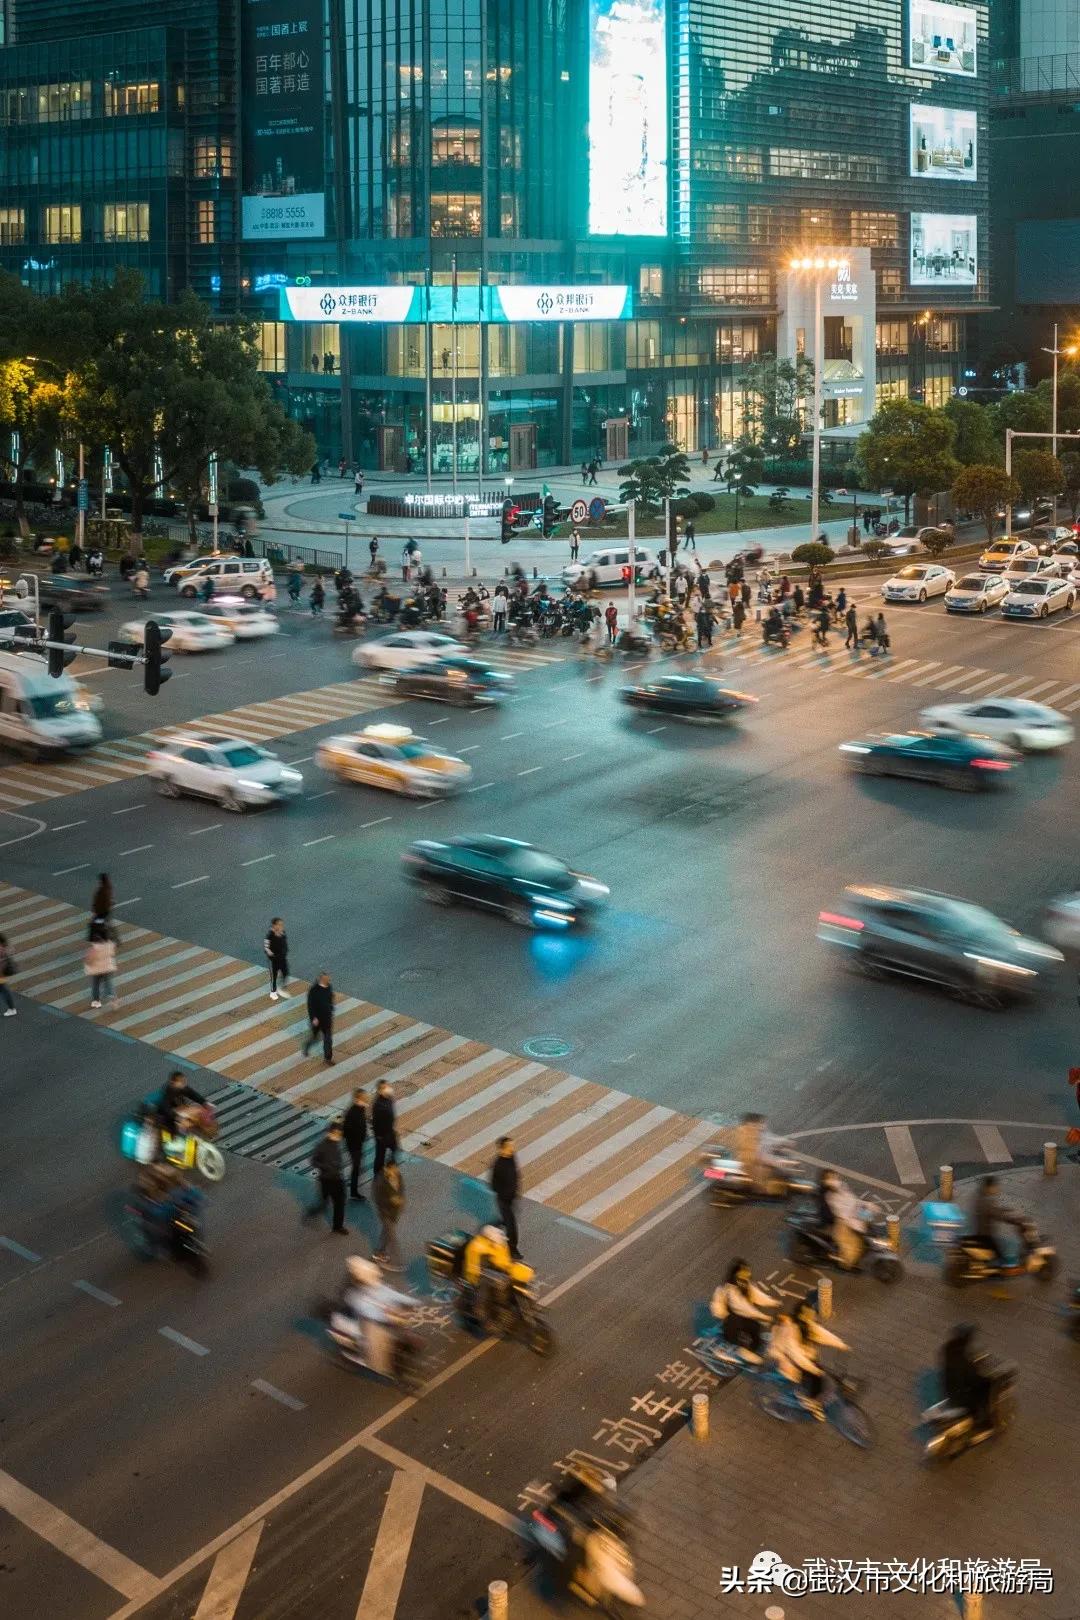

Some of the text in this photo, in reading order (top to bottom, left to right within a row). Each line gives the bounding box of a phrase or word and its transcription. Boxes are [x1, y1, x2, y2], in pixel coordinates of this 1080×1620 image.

[256, 50, 310, 73] 百年都心
[256, 73, 310, 95] 国著再造
[338, 294, 377, 307] 众邦银行
[556, 293, 594, 306] 众邦银行
[574, 506, 584, 518] 50
